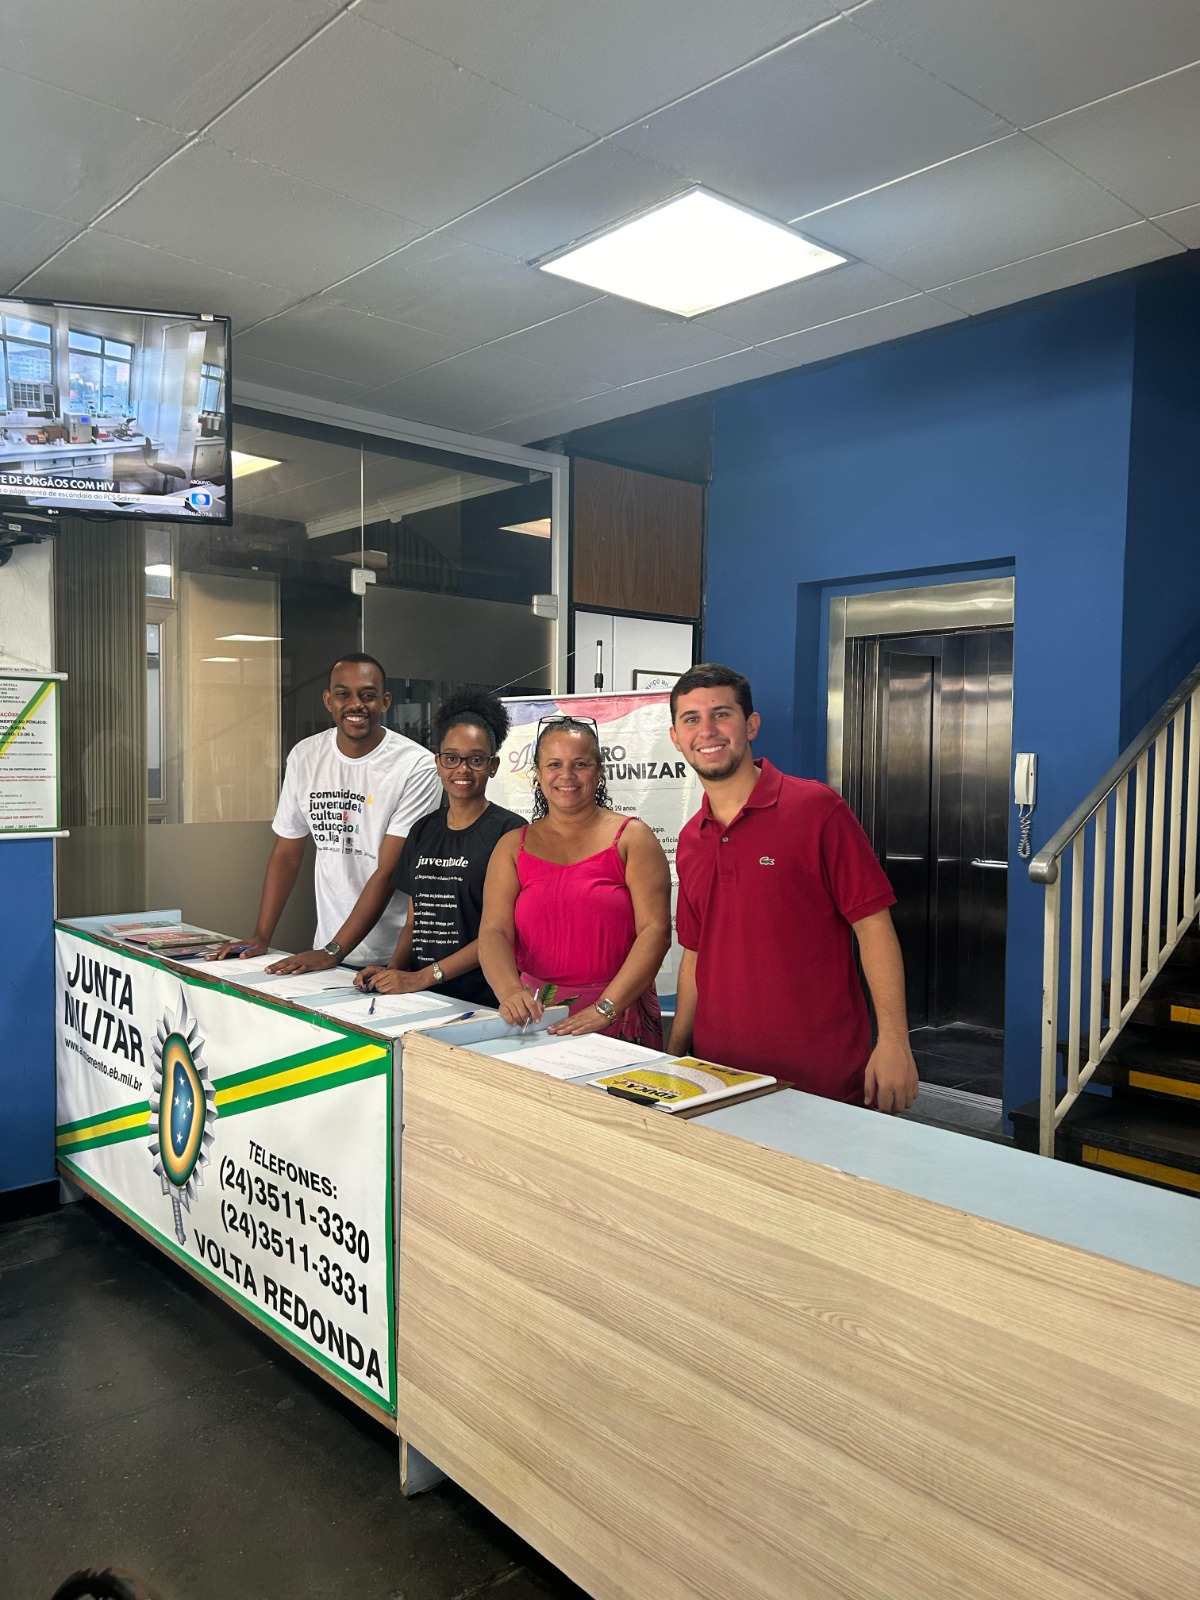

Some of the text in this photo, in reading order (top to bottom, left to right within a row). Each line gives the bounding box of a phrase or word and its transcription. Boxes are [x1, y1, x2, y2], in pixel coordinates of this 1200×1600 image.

[9, 475, 22, 485] DE
[24, 475, 68, 488] ÓRGÃOS
[70, 480, 96, 490] COM
[96, 482, 114, 492] HIV
[309, 800, 357, 812] juvenude
[310, 810, 342, 820] cultua
[416, 855, 469, 868] juventude
[67, 952, 133, 1015] JUNTA
[65, 990, 145, 1068] MILITAR
[626, 1083, 678, 1099] EDUCA
[249, 1140, 338, 1200] TELEFONES:
[220, 1155, 370, 1264] (24)3511-3330
[221, 1200, 368, 1314] (24)3511-3331
[194, 1228, 384, 1389] VOLTA REDONDA
